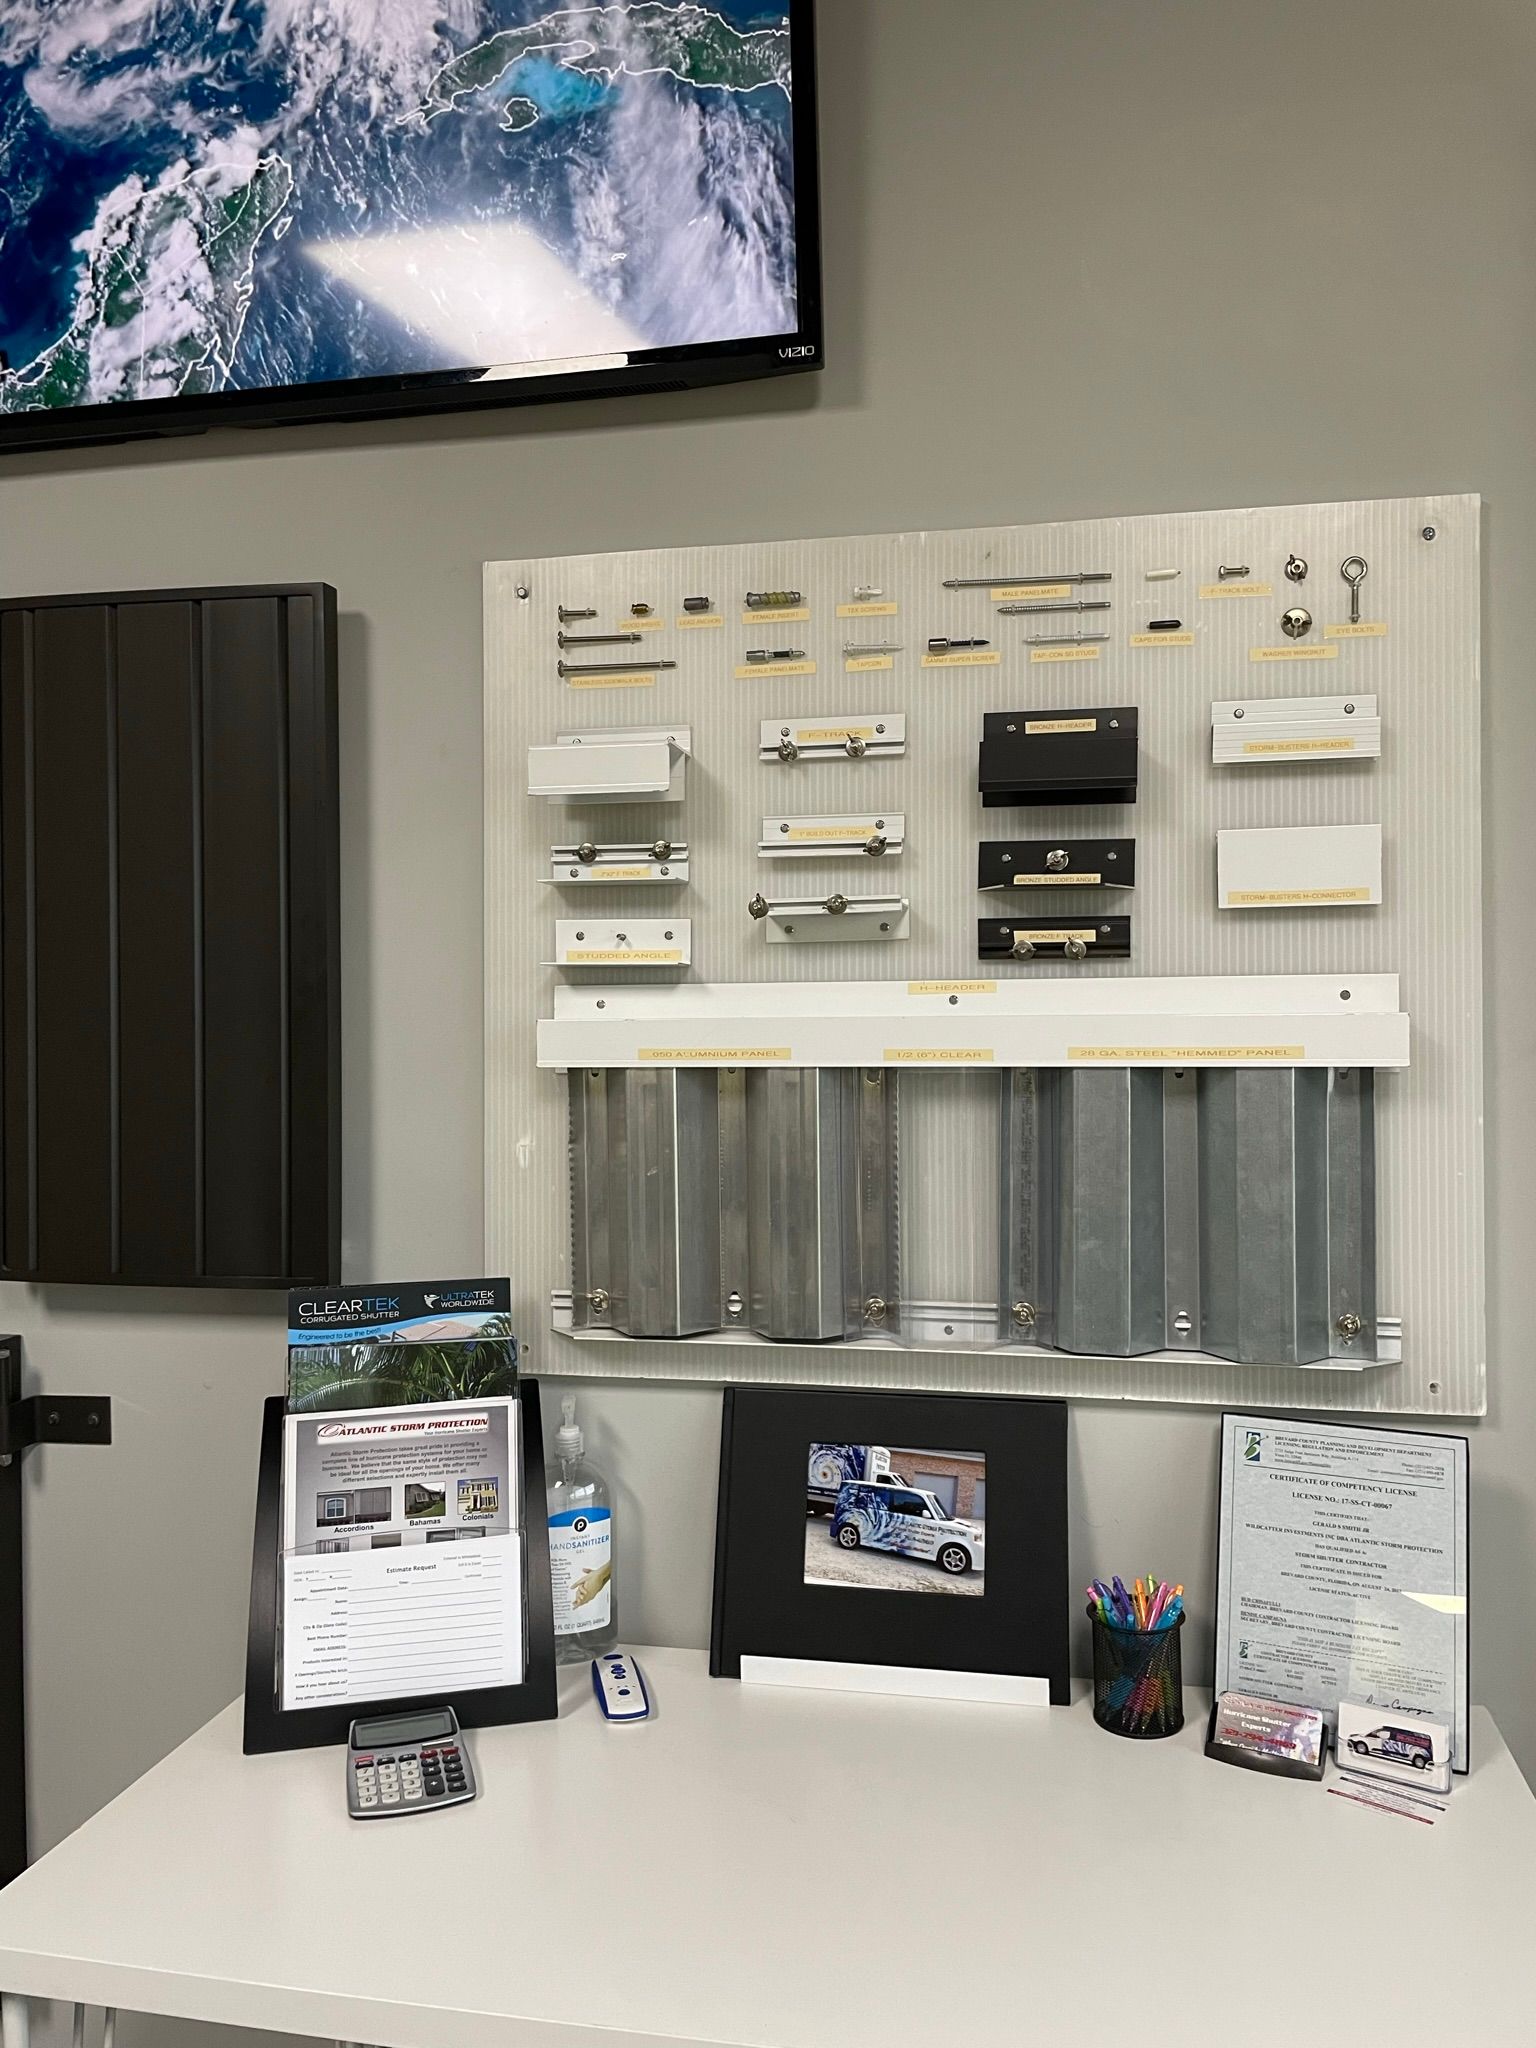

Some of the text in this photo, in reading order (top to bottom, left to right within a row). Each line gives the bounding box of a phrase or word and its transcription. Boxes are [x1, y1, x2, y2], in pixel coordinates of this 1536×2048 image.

[778, 345, 815, 358] VIZIO
[752, 611, 799, 621] FEMALE INSERT
[1351, 625, 1374, 633] BOLTS
[1057, 721, 1092, 729] H-HEADER
[808, 730, 862, 738] F-TRACK
[1241, 892, 1303, 901] STORM-BUSTERS
[577, 952, 672, 960] STUDDED ANGLE
[741, 1049, 780, 1057] PANEL
[439, 1290, 495, 1301] ULTRATEK
[298, 1296, 400, 1316] CLEARTEK
[440, 1298, 495, 1308] WORLDWIDE
[300, 1310, 400, 1324] CORRUGATED SHUTTER
[298, 1332, 336, 1341] Engineered
[354, 1329, 365, 1337] the
[338, 1417, 488, 1436] ATLANTIC STORM PROTECTION
[392, 1451, 420, 1459] protection
[1269, 1473, 1318, 1486] CERTIFICATE
[1331, 1480, 1384, 1494] COMPETENCY
[1384, 1487, 1418, 1497] LICENSE
[1292, 1491, 1324, 1502] LICENSE
[462, 1512, 494, 1522] Colonials
[409, 1518, 441, 1527] Bahamas
[1312, 1521, 1337, 1530] GERALD
[1341, 1525, 1361, 1533] SMITH
[334, 1524, 375, 1534] Accordions
[1245, 1522, 1283, 1534] WILDCATTER
[1283, 1527, 1325, 1540] INVESTMENTS
[1350, 1536, 1381, 1547] ATLANTIC
[1381, 1540, 1402, 1550] STORM
[1403, 1543, 1444, 1555] PROTECTION
[1295, 1551, 1388, 1570] STORM SHUTTER CONTRACTOR
[386, 1564, 437, 1574] Estimate Request
[1223, 1708, 1261, 1722] Hurricane
[1261, 1716, 1293, 1729] Shutter
[1241, 1721, 1271, 1734] Experts
